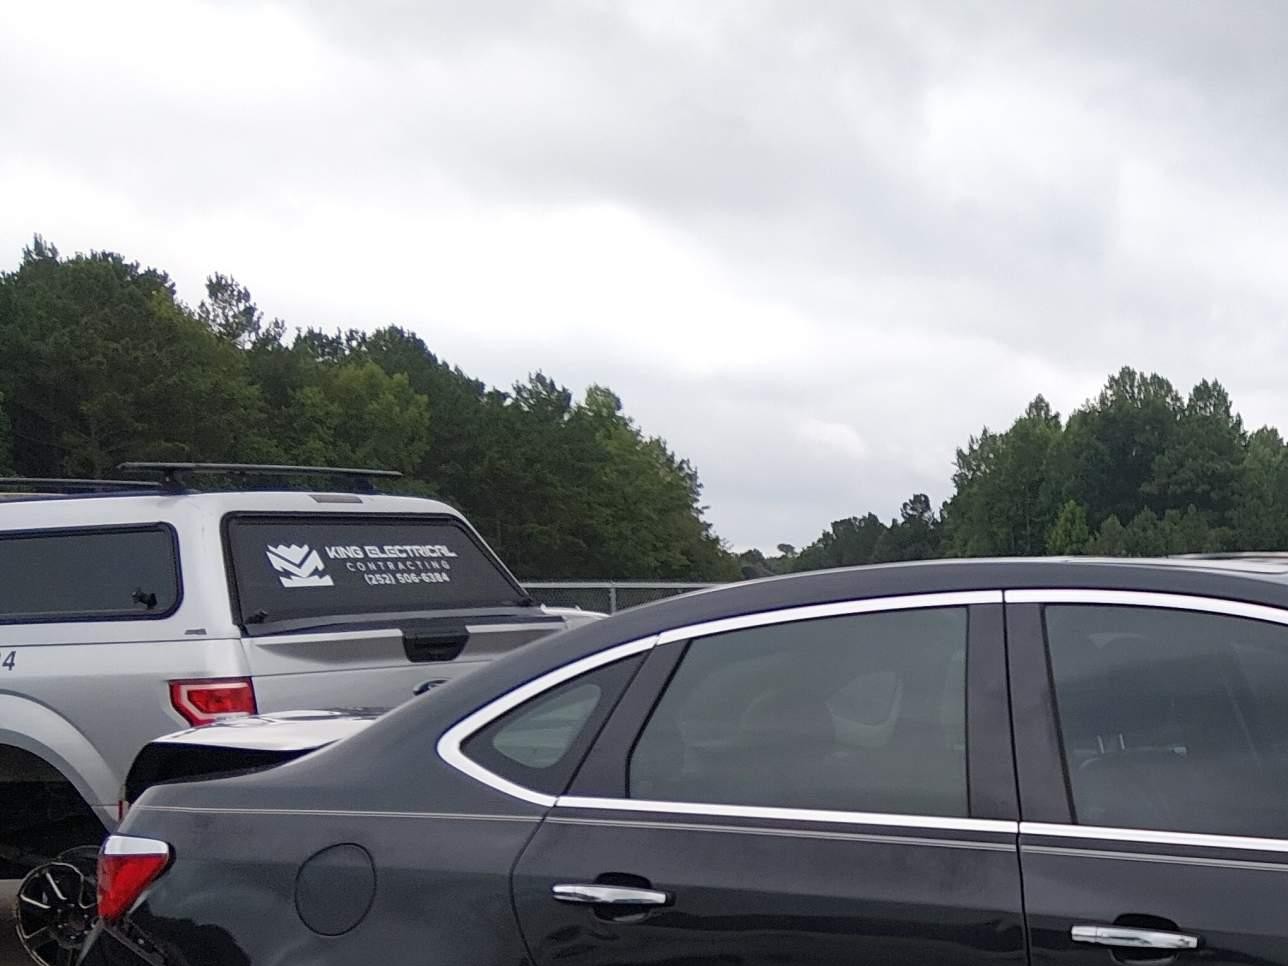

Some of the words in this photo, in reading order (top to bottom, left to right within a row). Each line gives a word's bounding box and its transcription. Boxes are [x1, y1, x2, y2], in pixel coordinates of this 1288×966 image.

[325, 546, 364, 558] KING
[364, 545, 457, 558] ELECTRICAL
[346, 560, 450, 571] CONTRACTING
[364, 573, 396, 585] (252)
